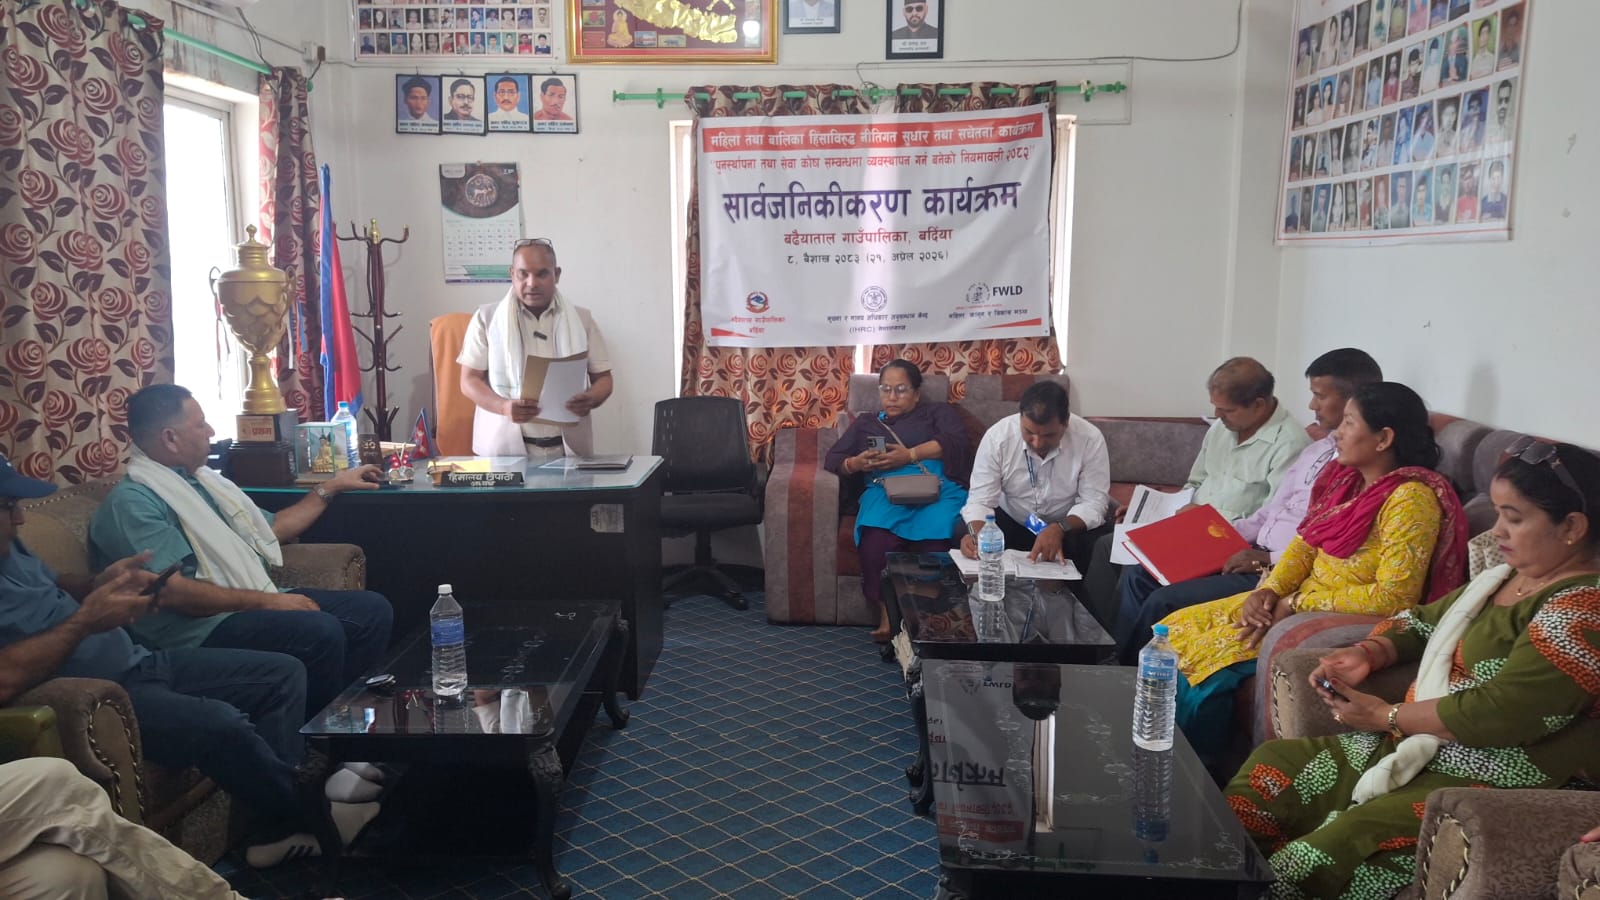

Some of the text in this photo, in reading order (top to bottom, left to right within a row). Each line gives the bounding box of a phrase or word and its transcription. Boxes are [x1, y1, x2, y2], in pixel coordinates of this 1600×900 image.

[711, 131, 741, 148] महिला
[745, 133, 765, 146] तथा
[768, 131, 804, 147] बालिका
[860, 128, 897, 144] नीतिगत
[902, 129, 929, 147] सुधार
[933, 127, 955, 141] तथा
[958, 125, 994, 141] सचेतना
[998, 121, 1036, 137] कार्यक्रम
[760, 157, 777, 169] तथा
[780, 155, 797, 169] सेवा
[801, 153, 820, 169] कोष
[960, 147, 1004, 164] नियमावली
[722, 177, 1022, 223] सार्वजनिकीकरण कार्यक्रम
[784, 229, 836, 246] बढैयाताल
[842, 226, 911, 246] गाउँपालिका,
[835, 253, 860, 264] २०८३
[992, 285, 1023, 296] FWLD
[849, 326, 875, 334] (IHRC)
